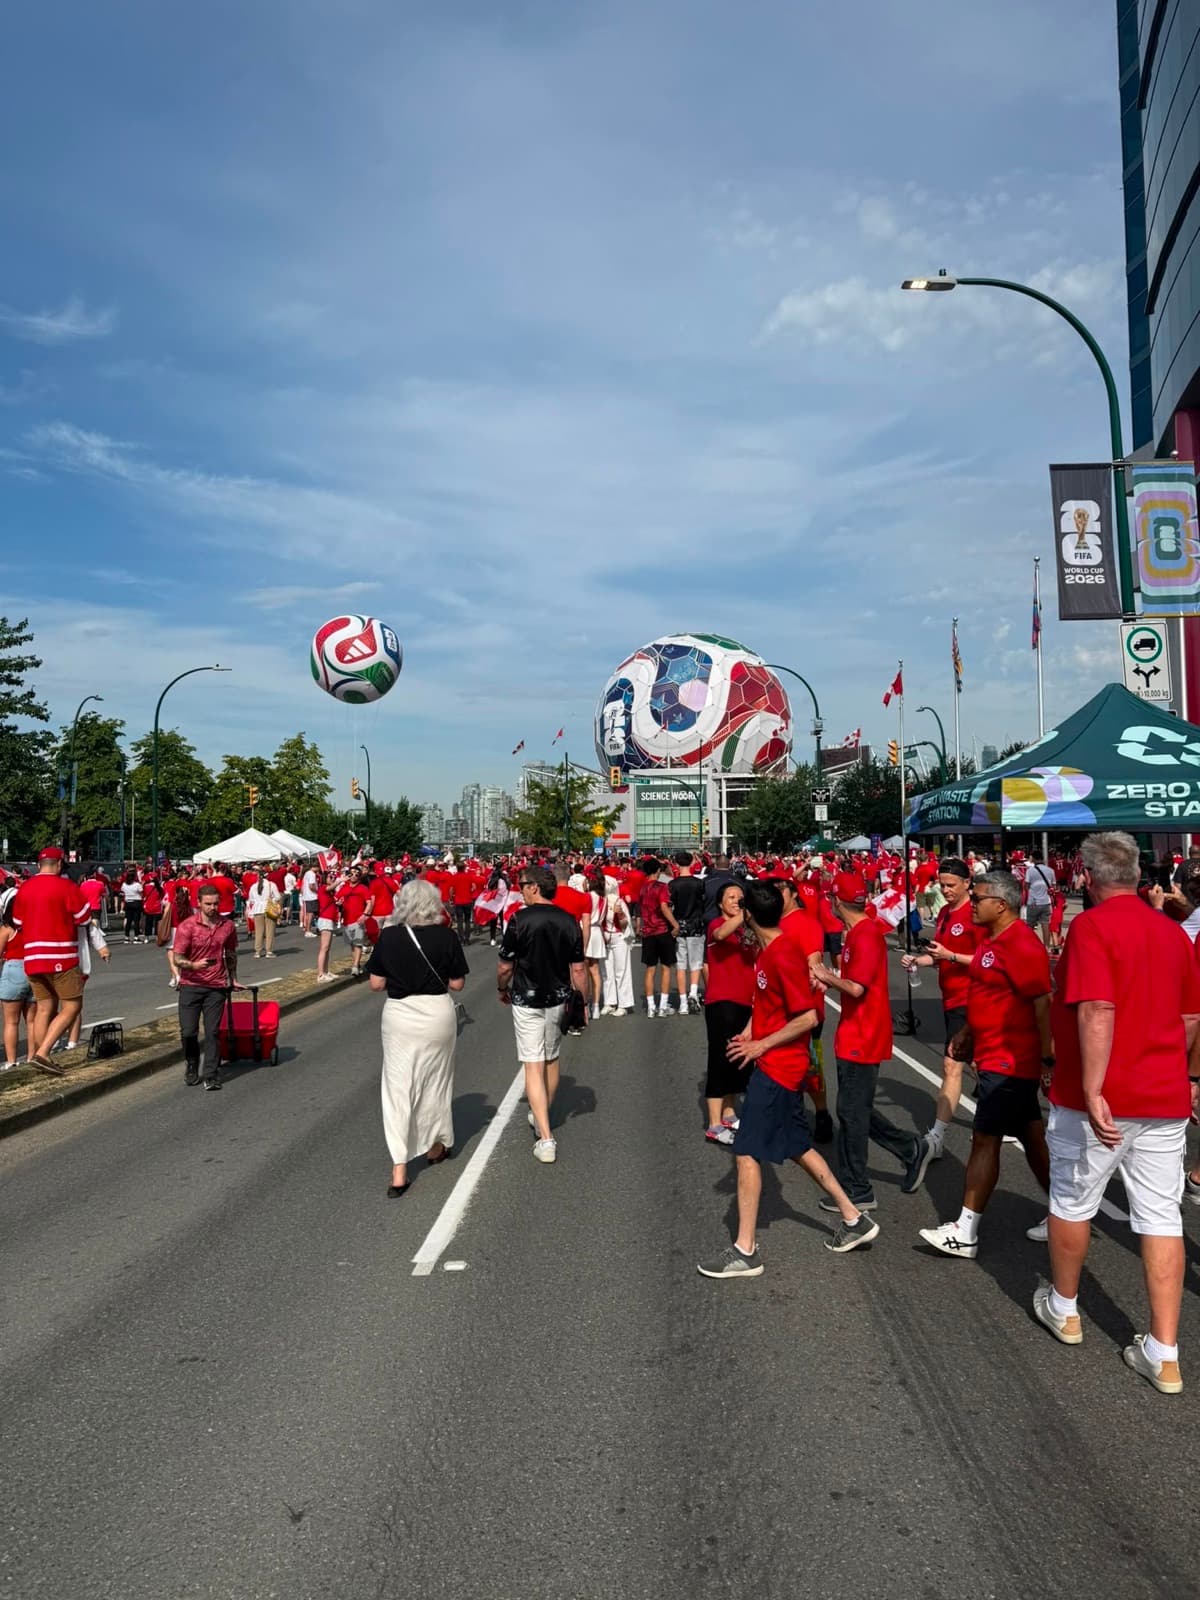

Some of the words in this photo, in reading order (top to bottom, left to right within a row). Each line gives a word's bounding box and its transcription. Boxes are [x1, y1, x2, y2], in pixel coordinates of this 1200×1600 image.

[1074, 552, 1092, 560] FIFA
[1064, 574, 1106, 584] 2026
[1162, 689, 1169, 699] kg
[640, 791, 671, 801] SCIENCE
[1105, 782, 1191, 799] ZERO
[920, 794, 938, 811] ZERO
[938, 789, 971, 804] WASTE
[927, 805, 960, 823] STATION
[1144, 800, 1200, 818] STA
